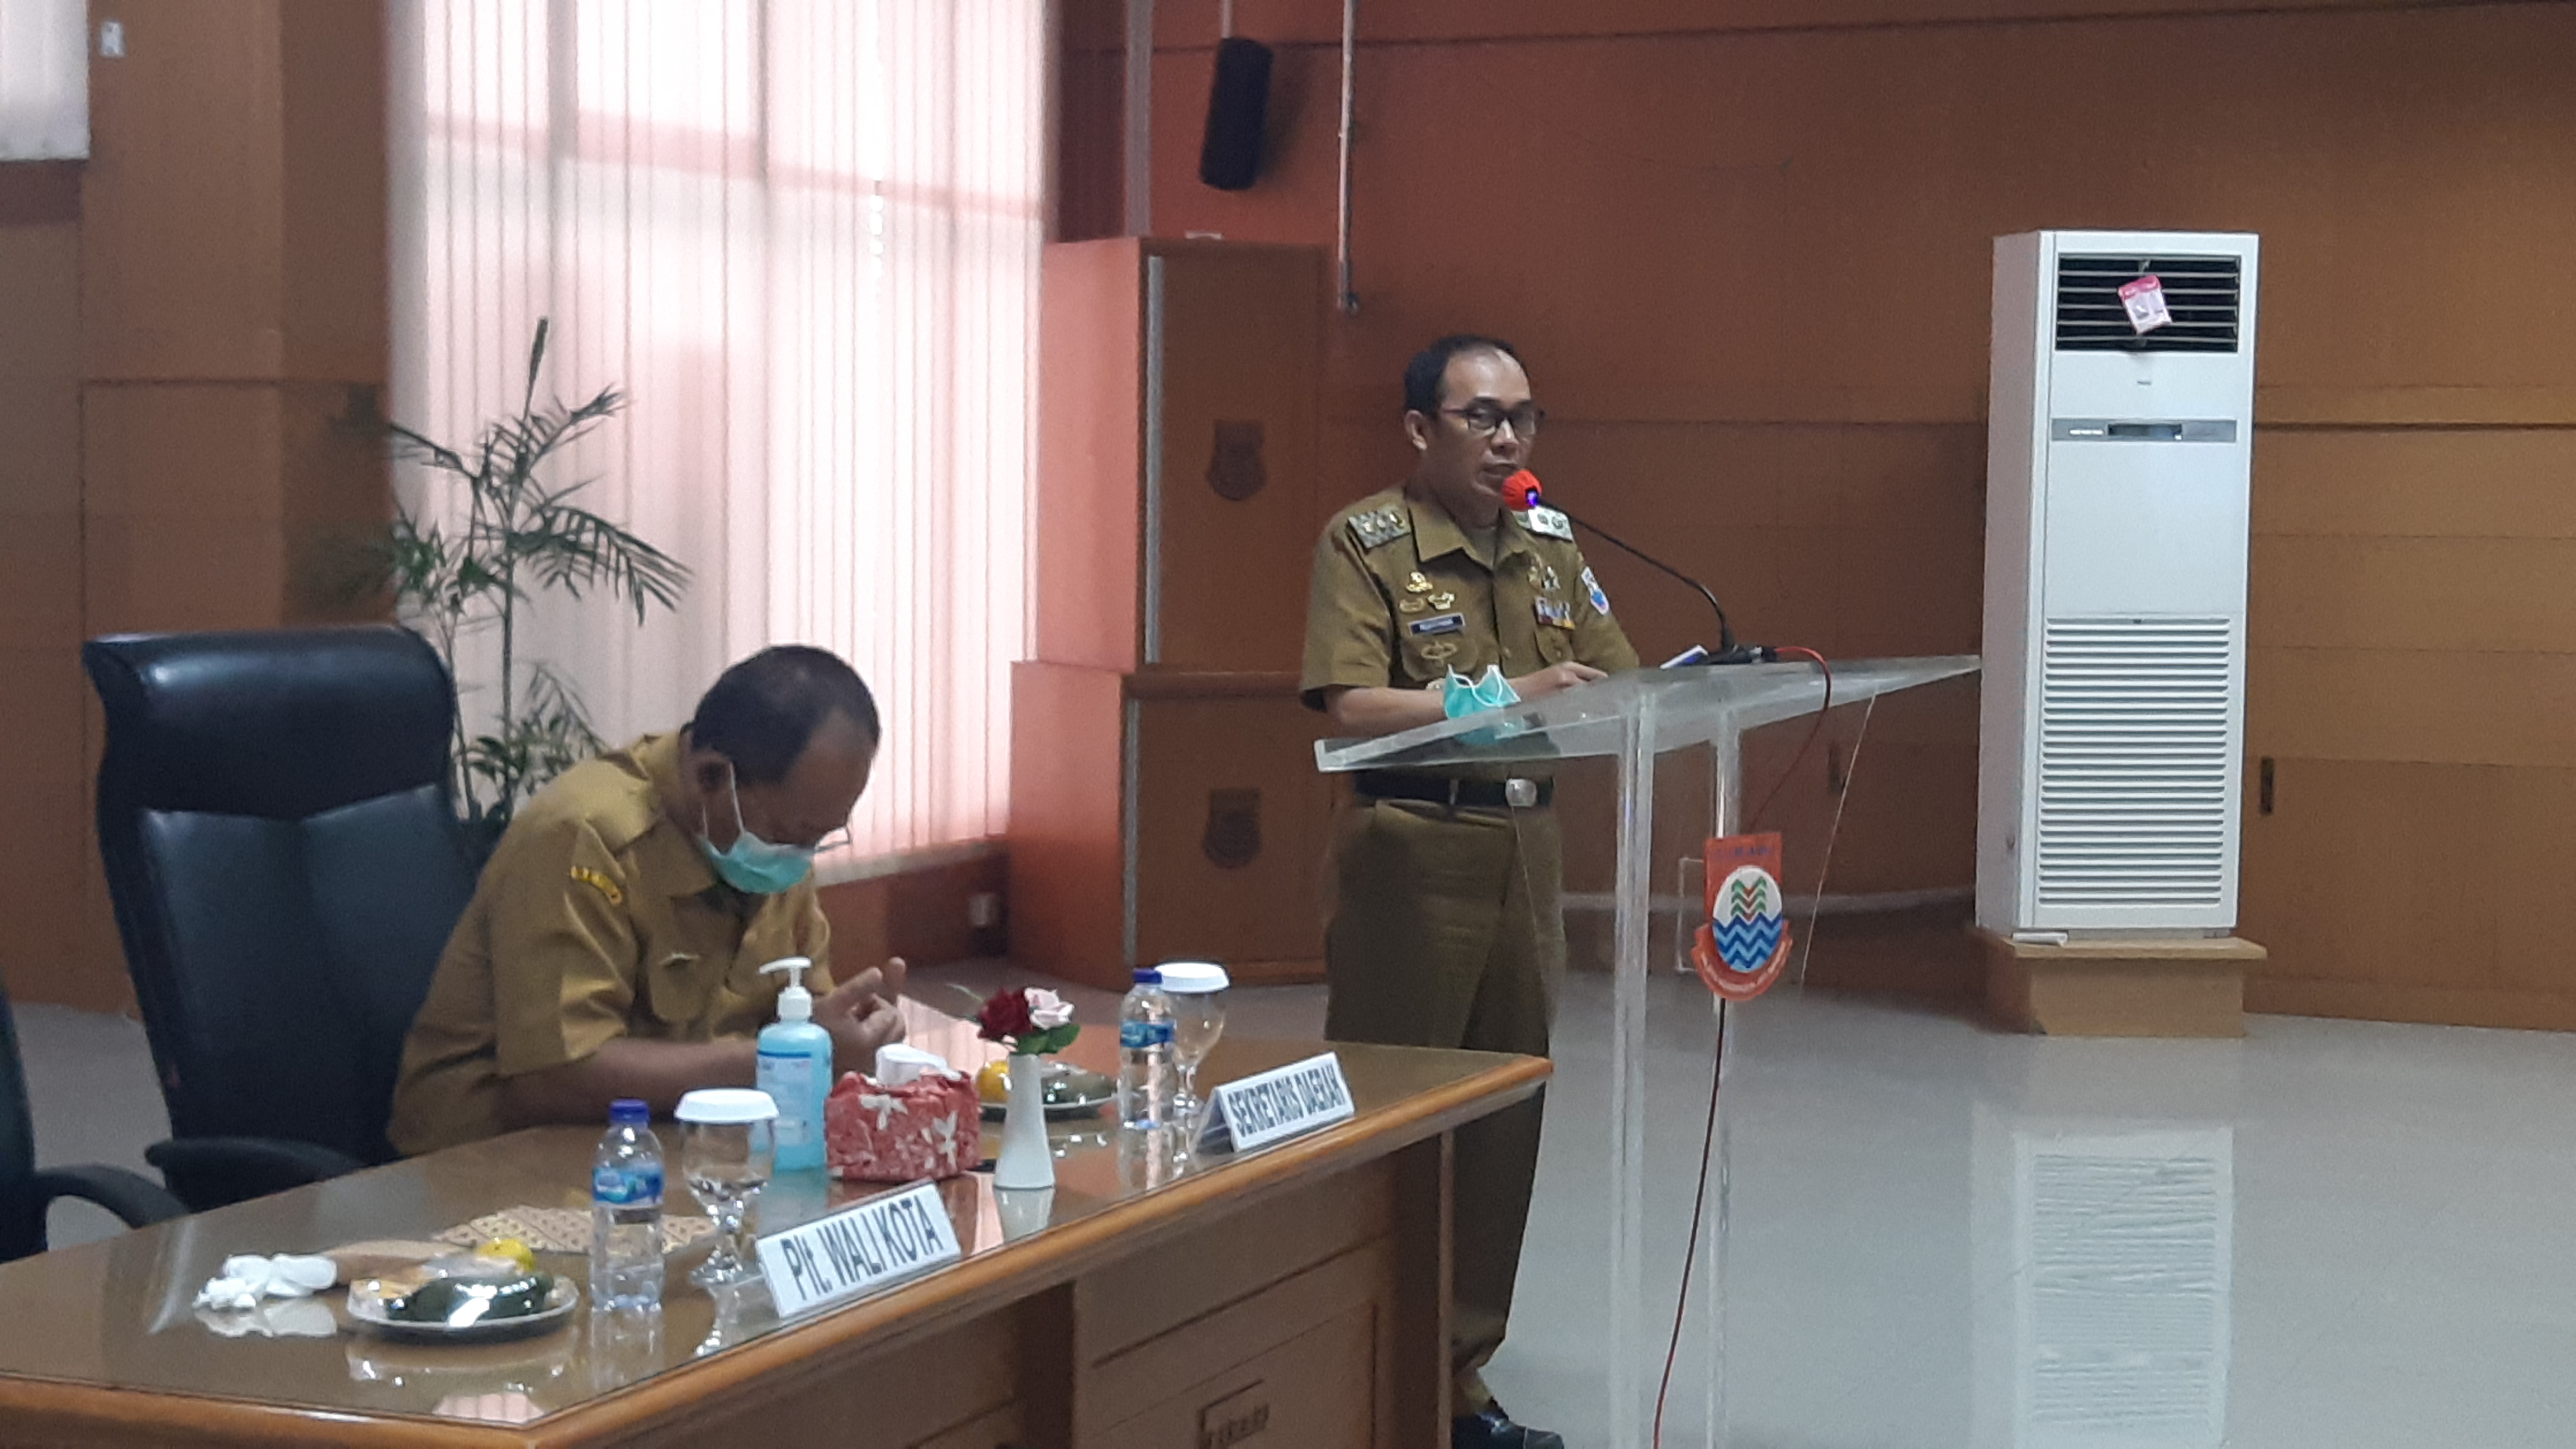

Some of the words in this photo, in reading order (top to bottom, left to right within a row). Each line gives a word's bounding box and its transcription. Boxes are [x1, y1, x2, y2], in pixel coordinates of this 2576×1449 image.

[1227, 1075, 1304, 1138] SEKRETARIS
[1293, 1063, 1345, 1115] DAERAH
[780, 1234, 833, 1301] Plt.
[817, 1213, 888, 1286] WALI
[872, 1195, 944, 1267] KOTA
